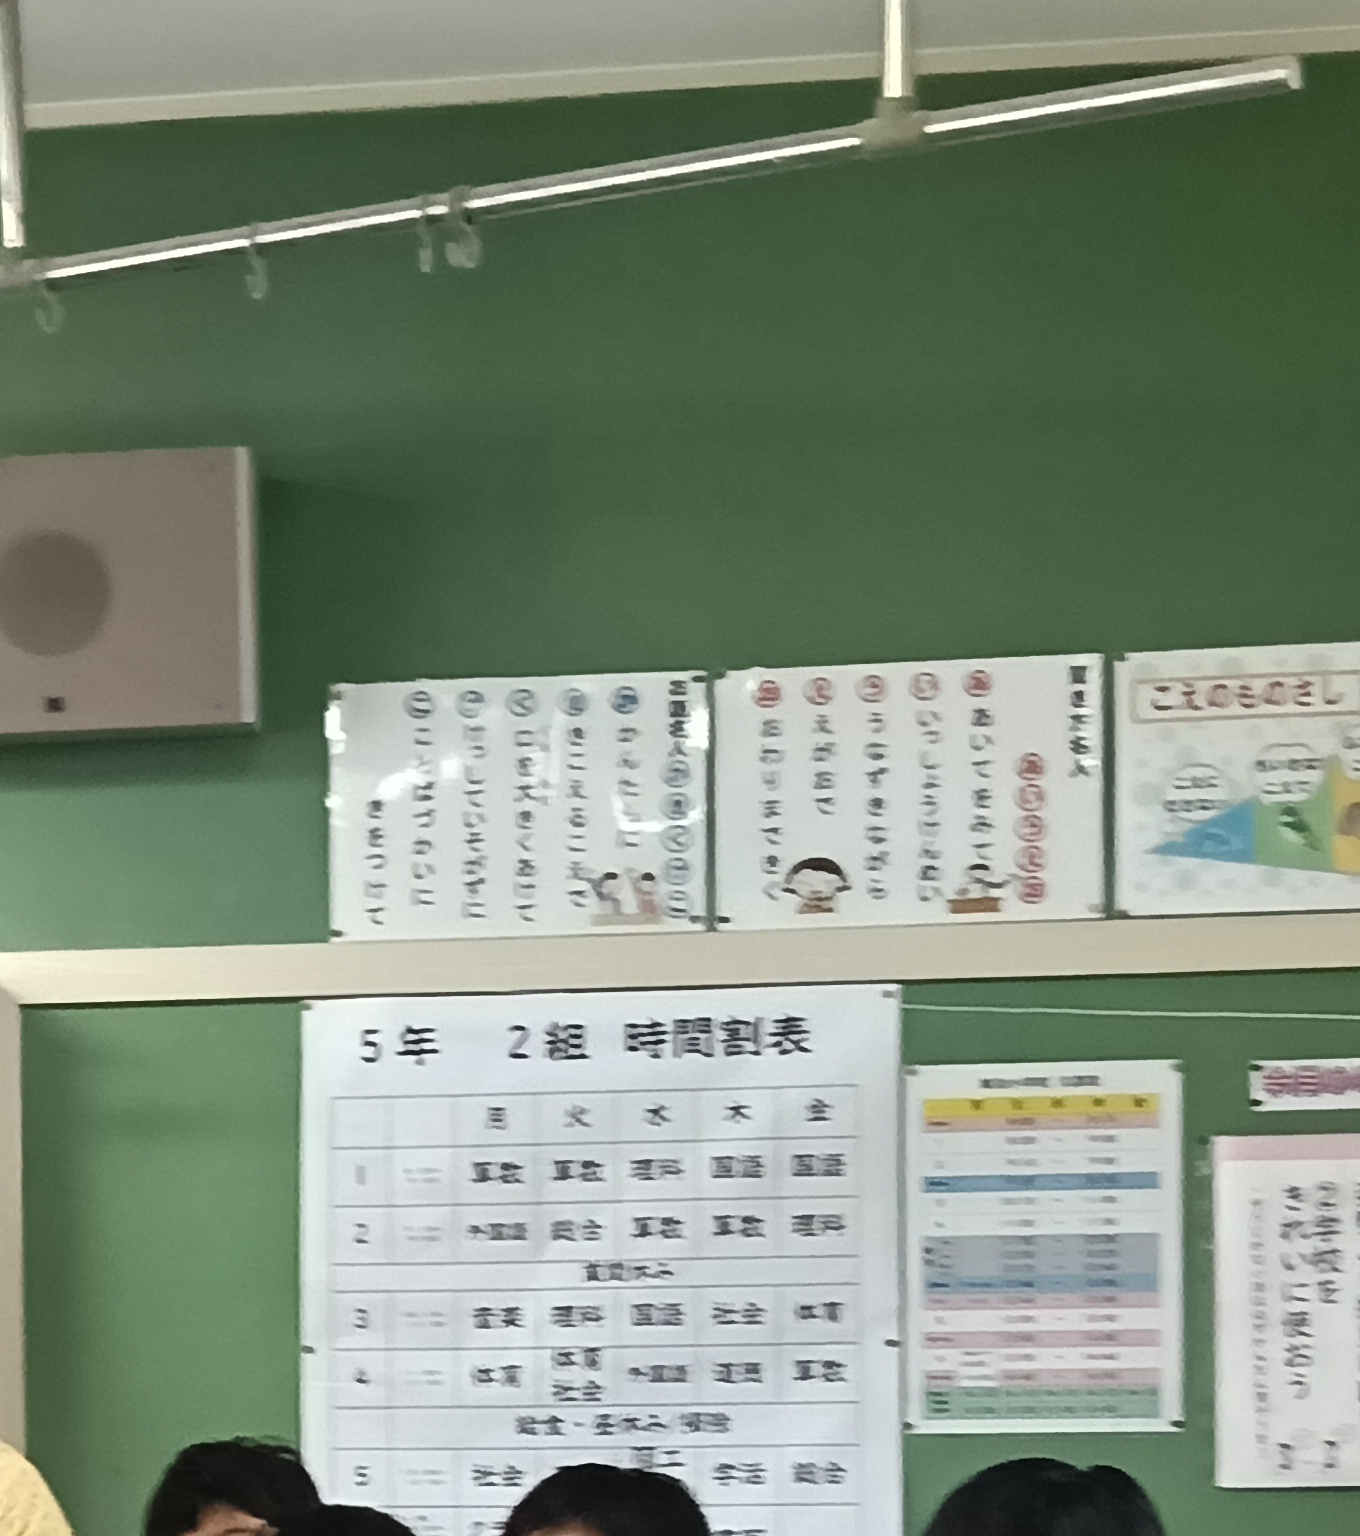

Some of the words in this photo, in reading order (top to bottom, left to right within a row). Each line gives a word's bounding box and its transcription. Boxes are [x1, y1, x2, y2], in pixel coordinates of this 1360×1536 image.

[360, 1025, 441, 1065] 5年
[506, 1021, 589, 1061] 2組
[623, 1015, 813, 1059] 時間割表
